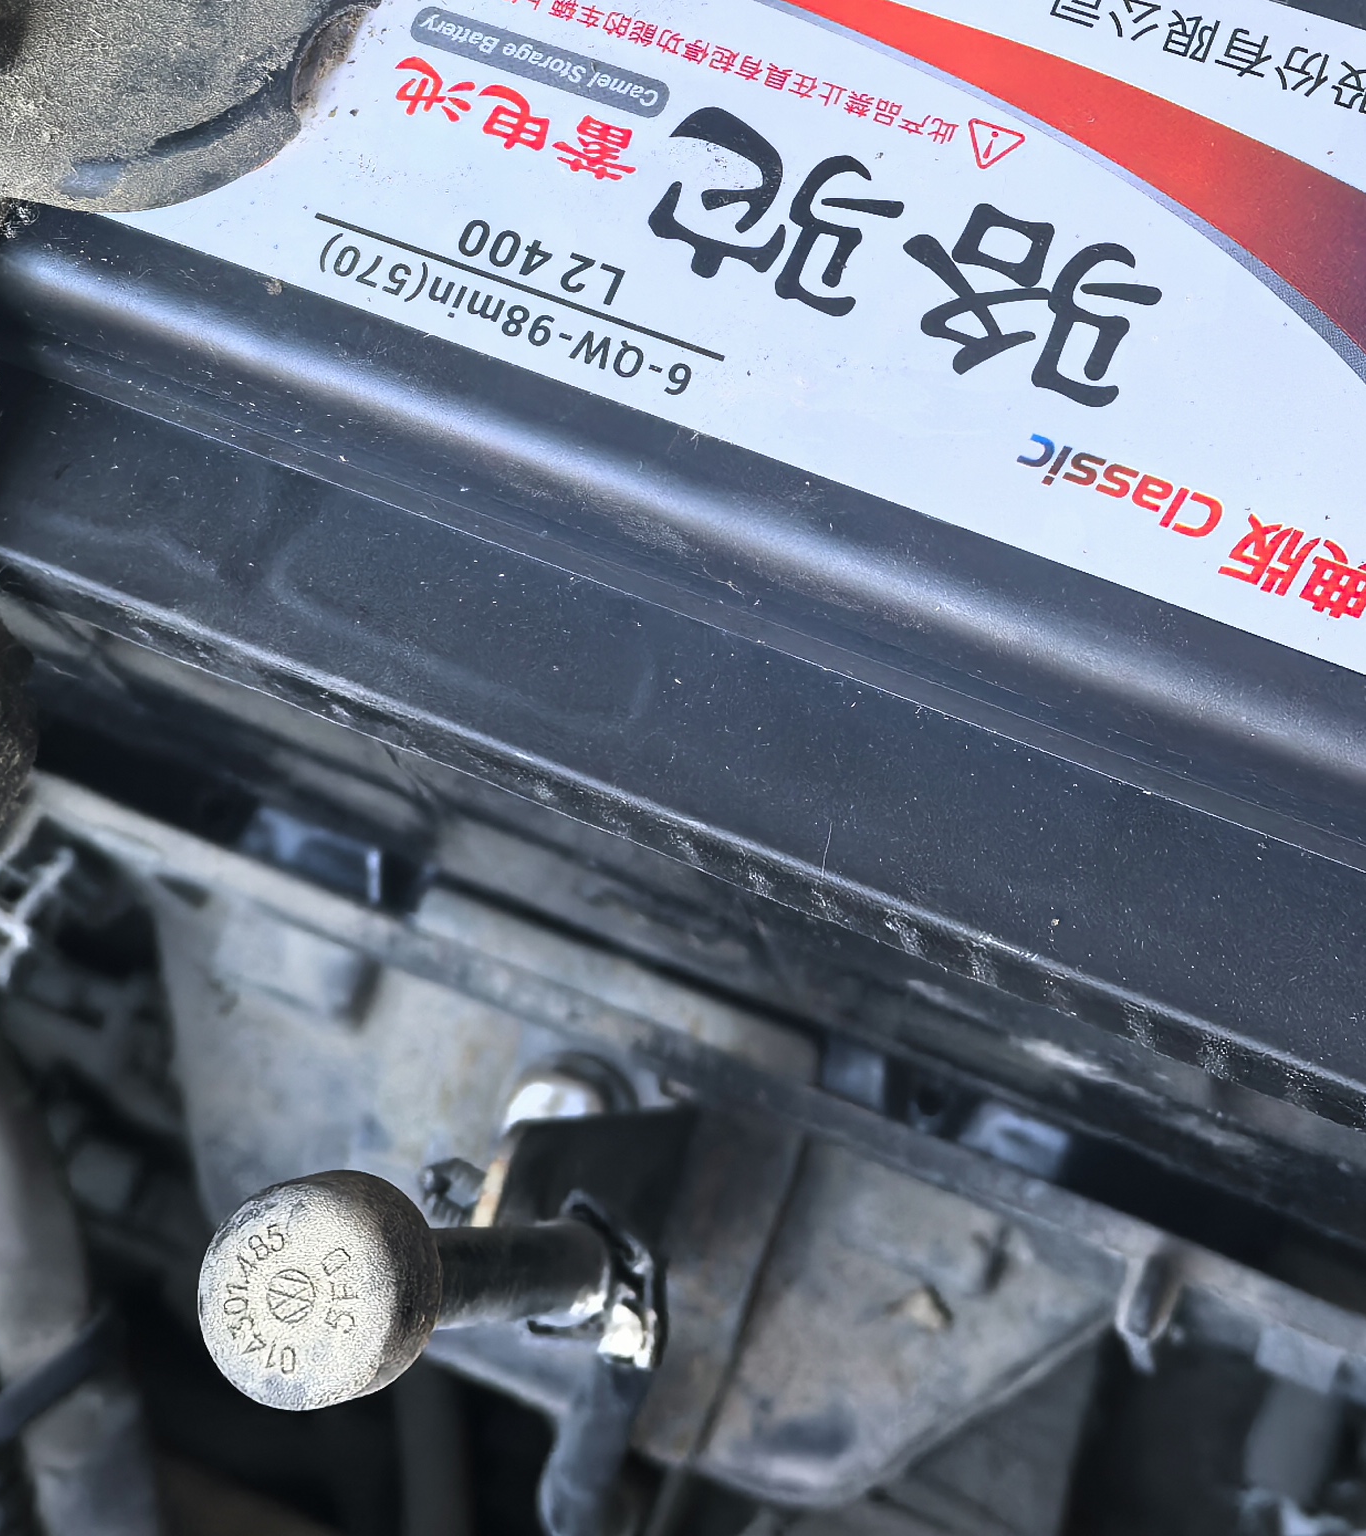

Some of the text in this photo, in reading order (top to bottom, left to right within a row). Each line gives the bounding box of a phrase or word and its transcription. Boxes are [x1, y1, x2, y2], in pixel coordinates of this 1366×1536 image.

[419, 14, 659, 107] Camel Storage Battery
[396, 56, 637, 181] 蓄电池
[319, 233, 692, 396] 6-QW-98min(570)
[458, 219, 625, 305] L2 400
[648, 106, 1163, 408] 骆驼
[1017, 433, 1223, 539] Classic
